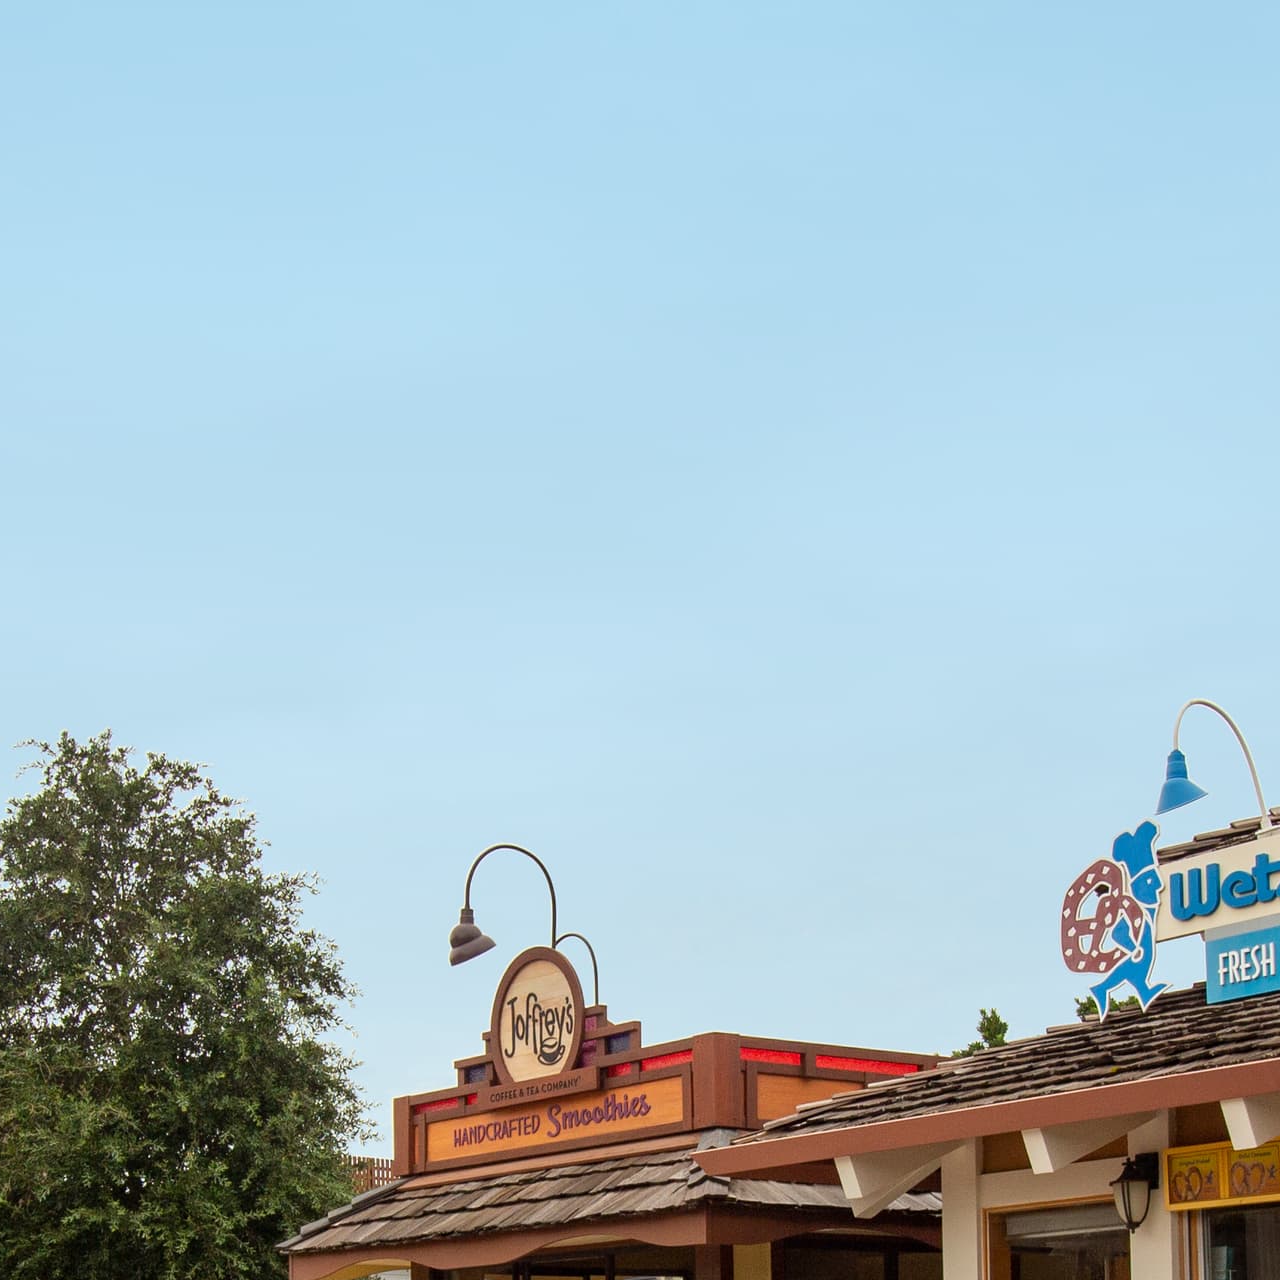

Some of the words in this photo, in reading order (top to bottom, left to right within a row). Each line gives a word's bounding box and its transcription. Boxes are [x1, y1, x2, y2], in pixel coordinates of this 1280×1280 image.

[1217, 940, 1276, 986] FRESH
[504, 992, 574, 1058] Joffrey's
[489, 1089, 518, 1104] COFFEE
[526, 1084, 540, 1097] TEA
[454, 1114, 541, 1149] HANDCRAFTED
[547, 1093, 652, 1139] Smoothies
